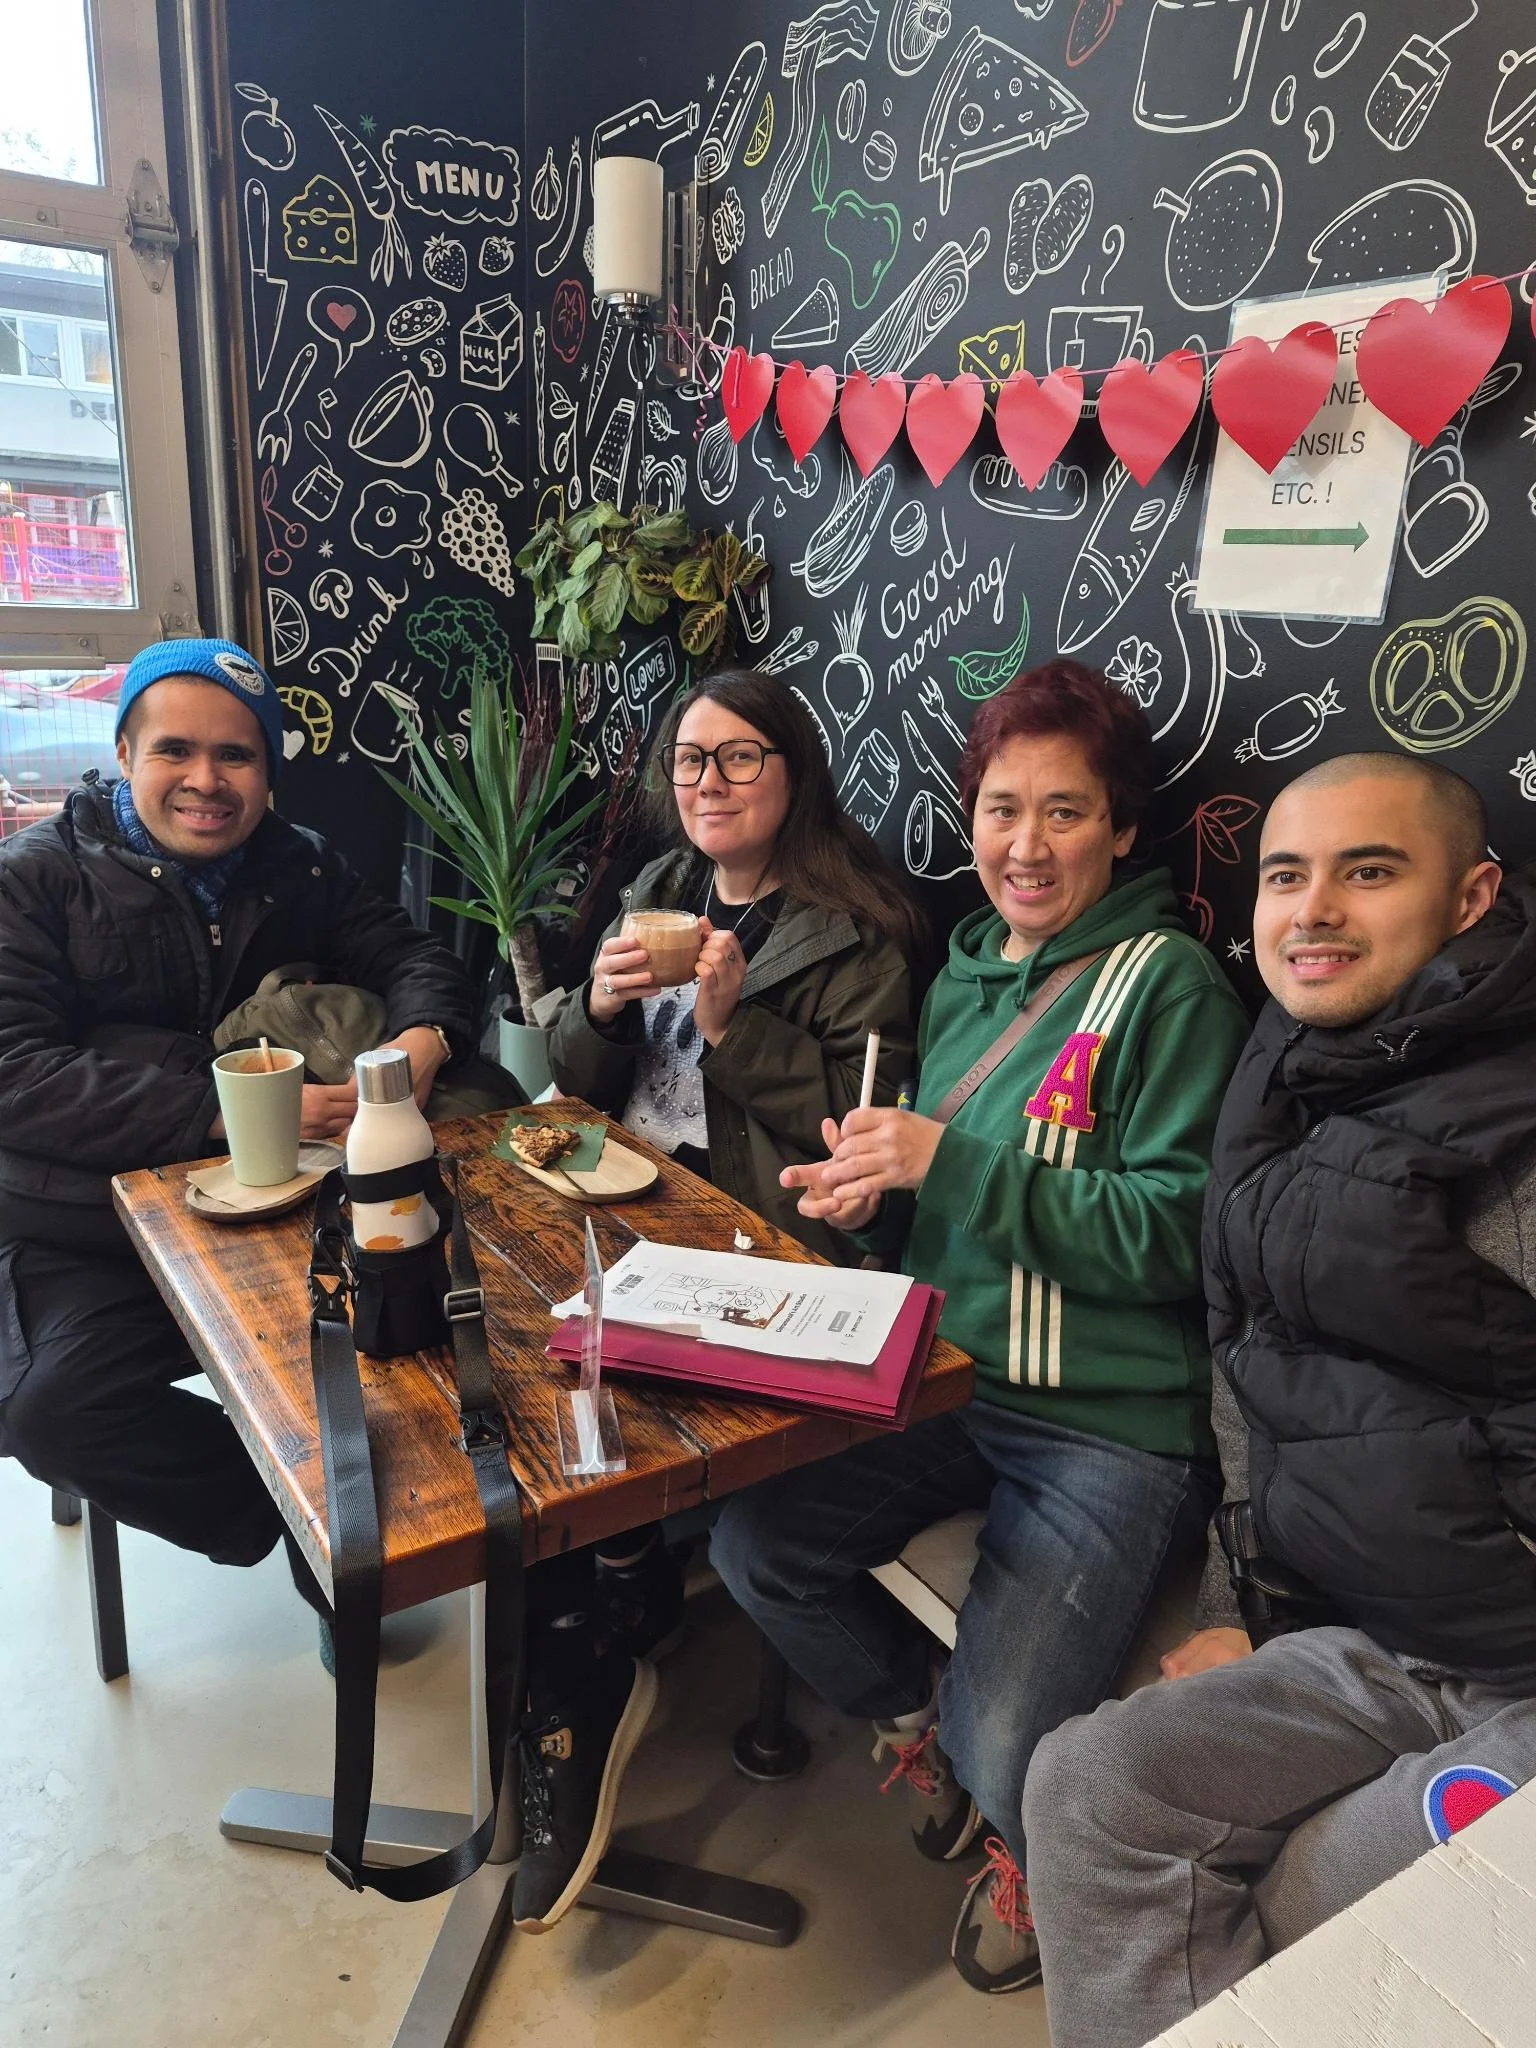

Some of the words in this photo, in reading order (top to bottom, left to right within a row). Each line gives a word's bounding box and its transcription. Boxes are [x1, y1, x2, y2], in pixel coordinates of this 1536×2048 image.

[415, 160, 505, 201] MENU
[750, 246, 794, 310] BREAD
[1271, 482, 1318, 505] ETC.
[881, 506, 967, 640] Good
[307, 576, 410, 698] Drink
[888, 541, 1016, 696] morning
[630, 652, 666, 700] LOVE
[1023, 1032, 1105, 1133] A
